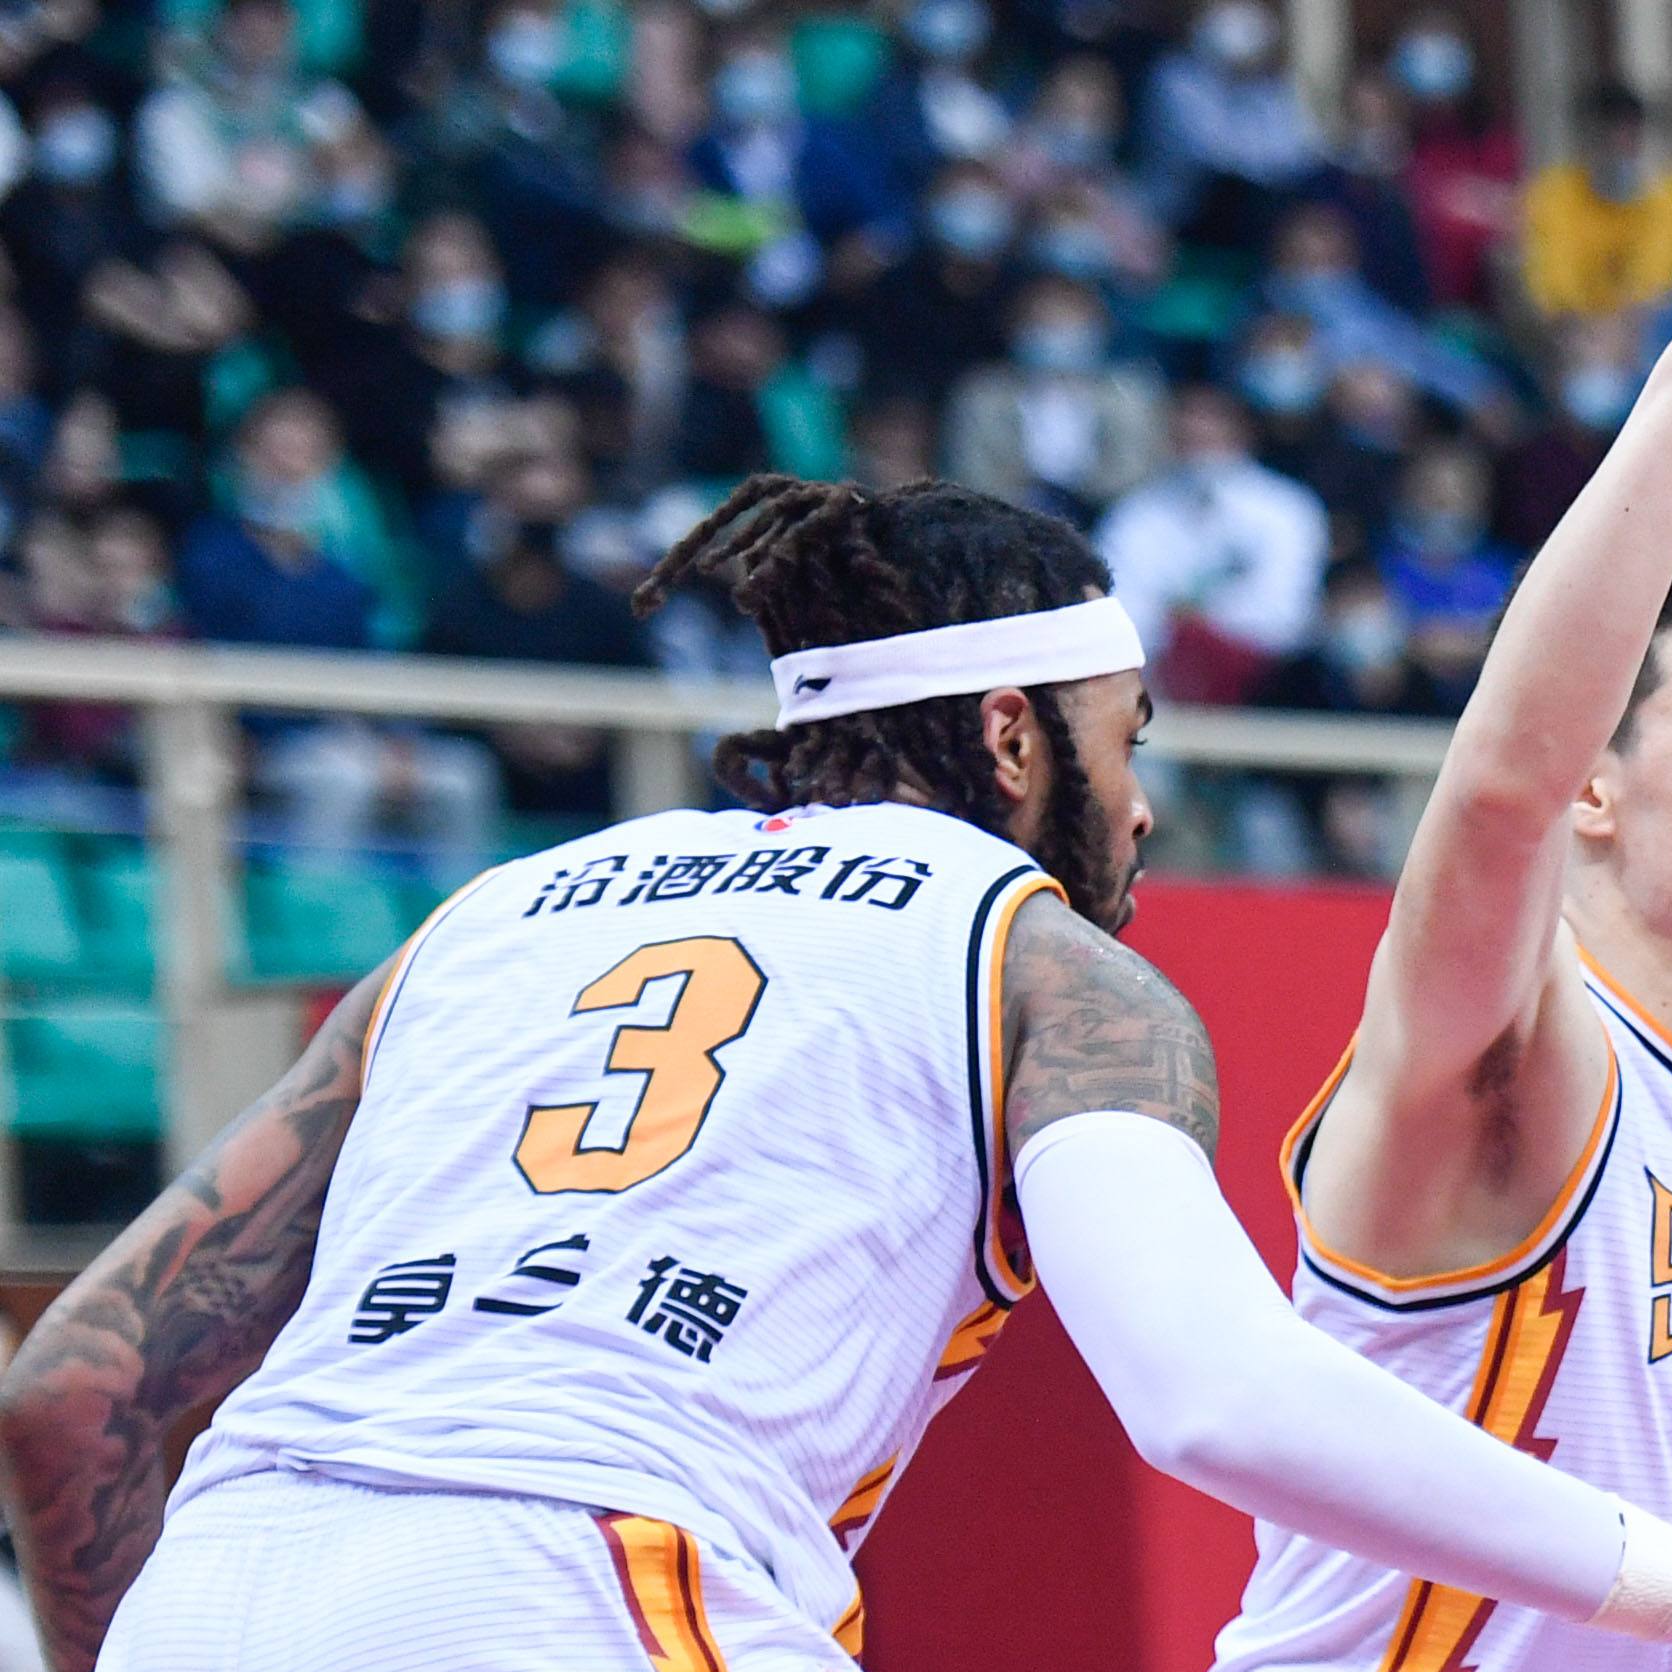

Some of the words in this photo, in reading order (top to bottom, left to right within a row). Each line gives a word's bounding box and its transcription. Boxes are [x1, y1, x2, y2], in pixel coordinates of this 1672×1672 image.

[523, 844, 934, 918] 汾酒股份
[513, 934, 768, 1195] 3
